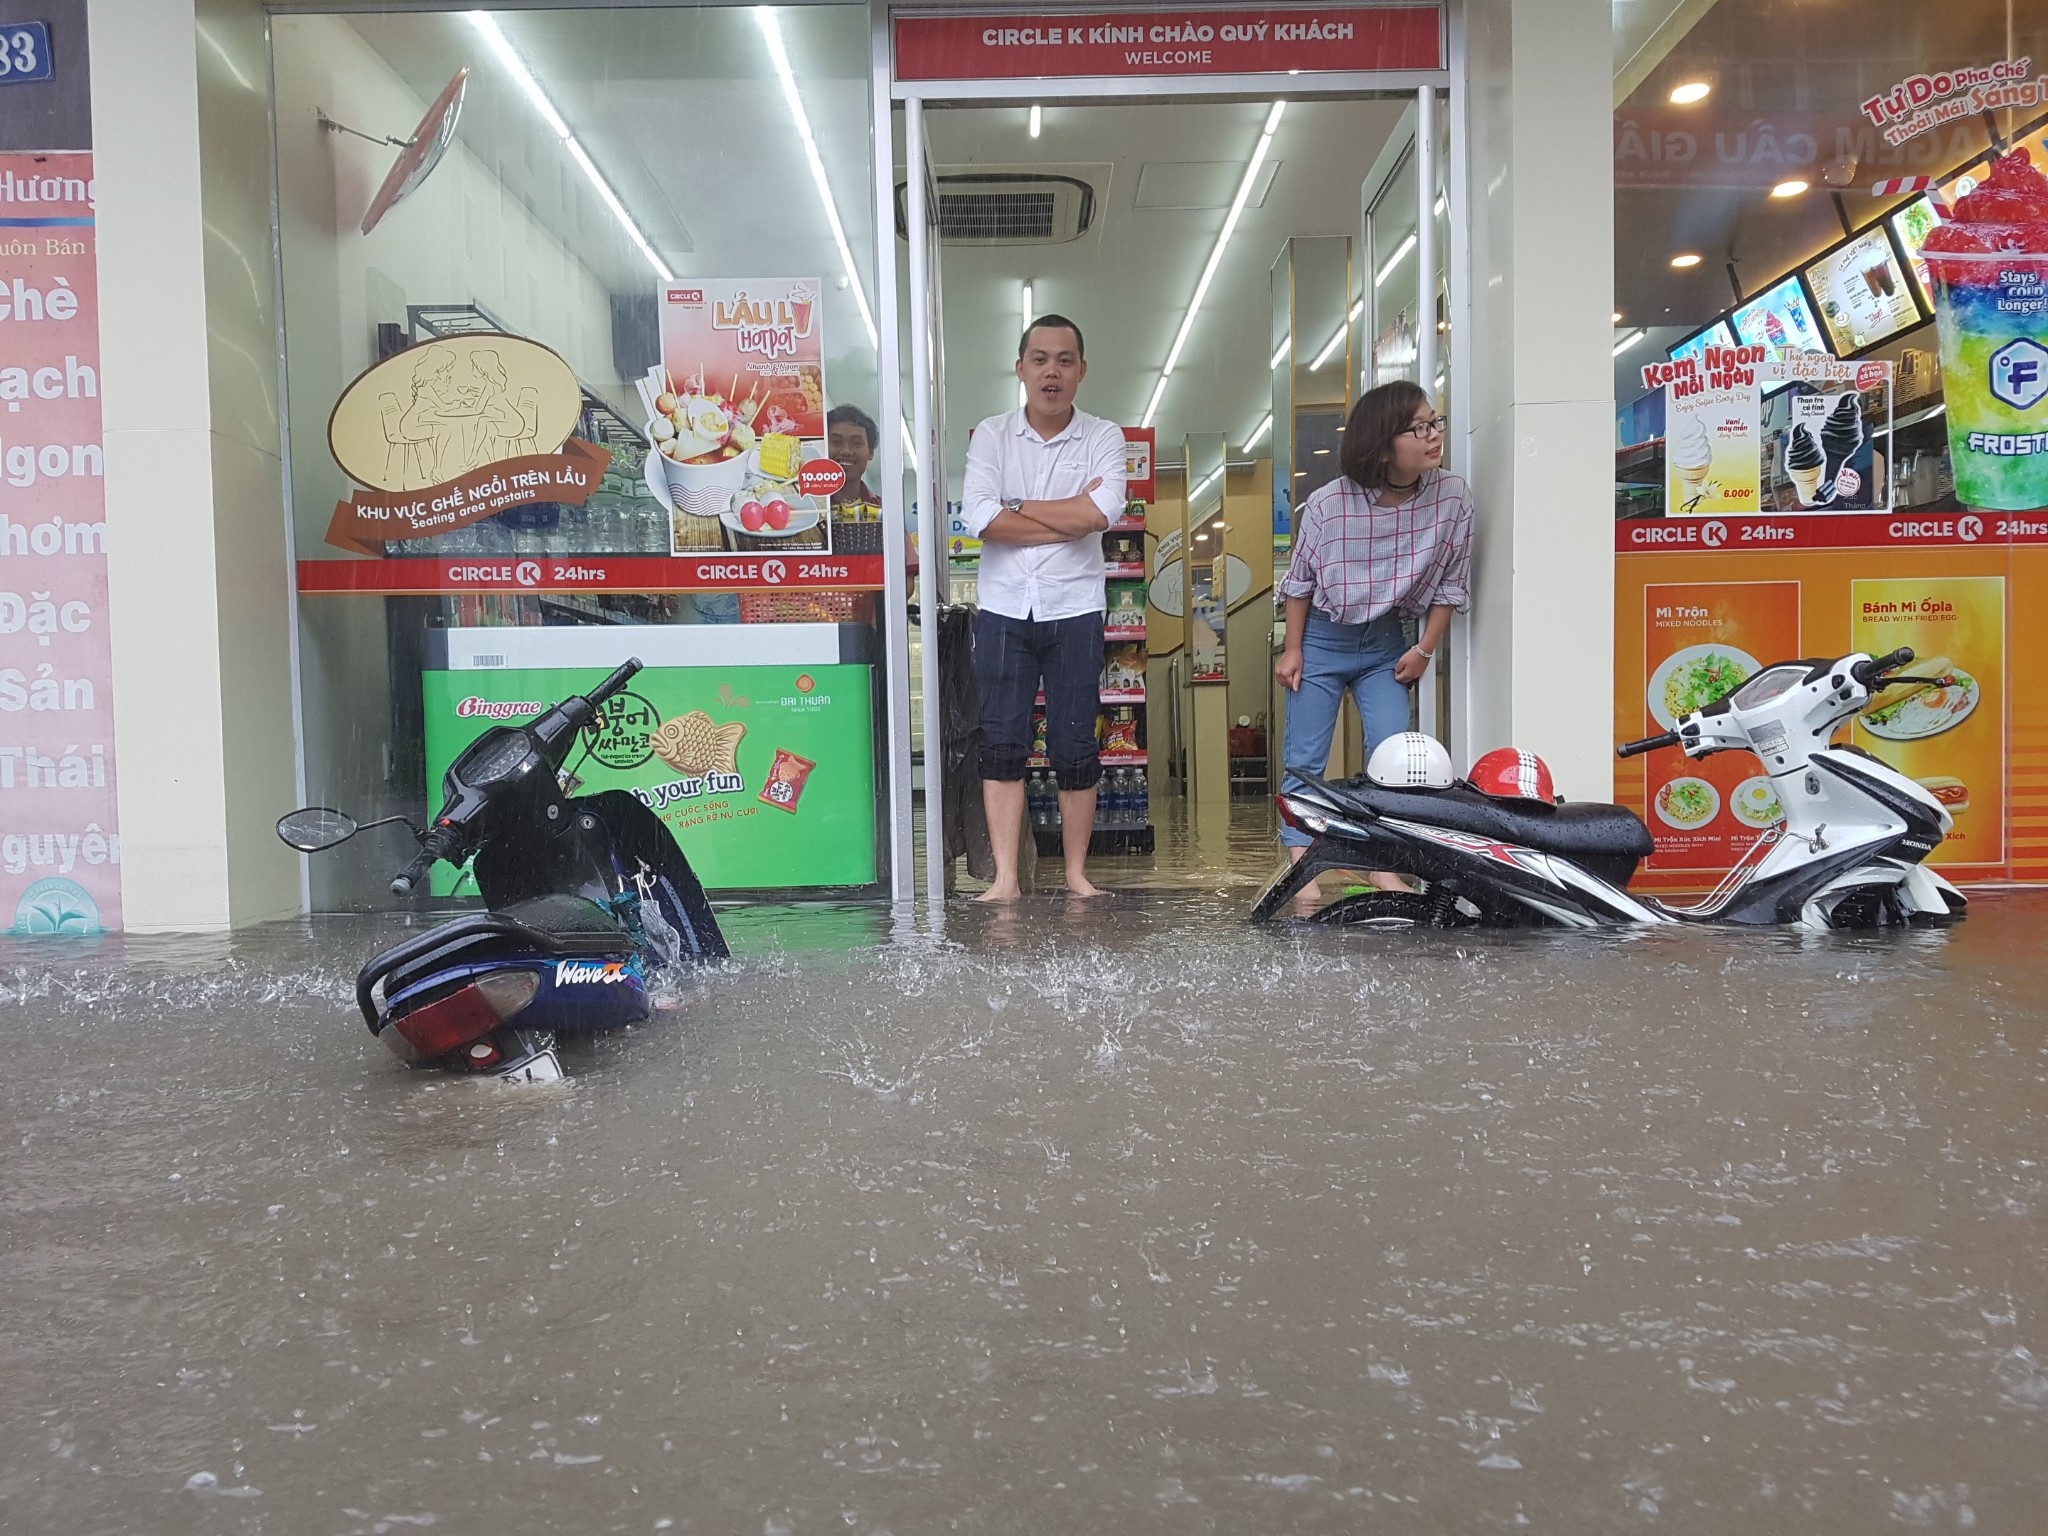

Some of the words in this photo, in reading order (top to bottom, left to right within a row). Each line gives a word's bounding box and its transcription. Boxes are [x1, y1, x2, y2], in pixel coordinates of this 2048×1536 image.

[982, 28, 1062, 46] CIRCLE
[1068, 28, 1084, 45] K
[1089, 22, 1144, 44] KÍNH
[1149, 20, 1215, 43] CHÀO
[1220, 19, 1269, 43] QUÝ
[1275, 19, 1354, 41] KHÁCH
[1124, 50, 1212, 65] WELCOME
[1906, 75, 1951, 105] Do
[1993, 58, 2031, 80] Chế
[1935, 102, 1967, 121] Mái
[1970, 83, 2037, 111] Sáng
[45, 238, 86, 256] Bán
[2000, 271, 2037, 287] Stays
[692, 292, 700, 300] K
[2008, 286, 2045, 298] COLD
[1997, 298, 2048, 314] Longer!
[746, 363, 772, 372] Nhanh
[771, 363, 779, 376] &
[779, 362, 800, 373] Ngon
[1643, 357, 1696, 388] Kem
[1704, 345, 1766, 372] Ngon
[1824, 362, 1852, 381] biệt
[1673, 374, 1705, 400] Mỗi
[1710, 366, 1755, 390] Ngày
[1969, 431, 2048, 457] FROST
[0, 436, 103, 488] gon
[356, 504, 390, 520] KHU
[394, 500, 427, 521] VỰC
[431, 487, 465, 512] GHẾ
[468, 474, 507, 502] NGỒI
[510, 468, 550, 490] TRÊN
[555, 465, 587, 486] LẦU
[411, 511, 456, 530] Seating
[459, 502, 486, 517] area
[489, 488, 536, 509] upstairs
[1631, 527, 1697, 542] CIRCLE
[1704, 523, 1725, 544] K
[1741, 525, 1795, 541] 24hrs
[1889, 521, 1953, 537] CIRCLE
[1960, 518, 1981, 538] K
[1996, 521, 2048, 535] 24hrs
[449, 566, 511, 581] CIRCLE
[517, 563, 539, 583] K
[554, 565, 606, 581] 24hrs
[697, 564, 758, 580] CIRCLE
[763, 562, 784, 582] K
[798, 563, 848, 579] 24hrs
[1656, 606, 1672, 618] Mì
[1675, 605, 1709, 619] Trộn
[1863, 601, 1898, 614] Bánh
[1901, 600, 1918, 613] Mì
[1921, 597, 1952, 615] Ốpla
[0, 591, 91, 646] Đặc
[1683, 619, 1723, 627] NOODLES
[1862, 615, 1890, 623] BREAD
[1892, 615, 1914, 623] WITH
[1916, 614, 1940, 622] FRIED
[1943, 614, 1958, 622] EGG
[0, 662, 94, 712] Sản
[457, 696, 541, 719] Binggrae
[0, 744, 105, 789] Thái
[654, 778, 700, 806] your
[706, 771, 741, 791] fun
[1901, 839, 1932, 851] HONDA
[1945, 832, 1966, 840] Xích
